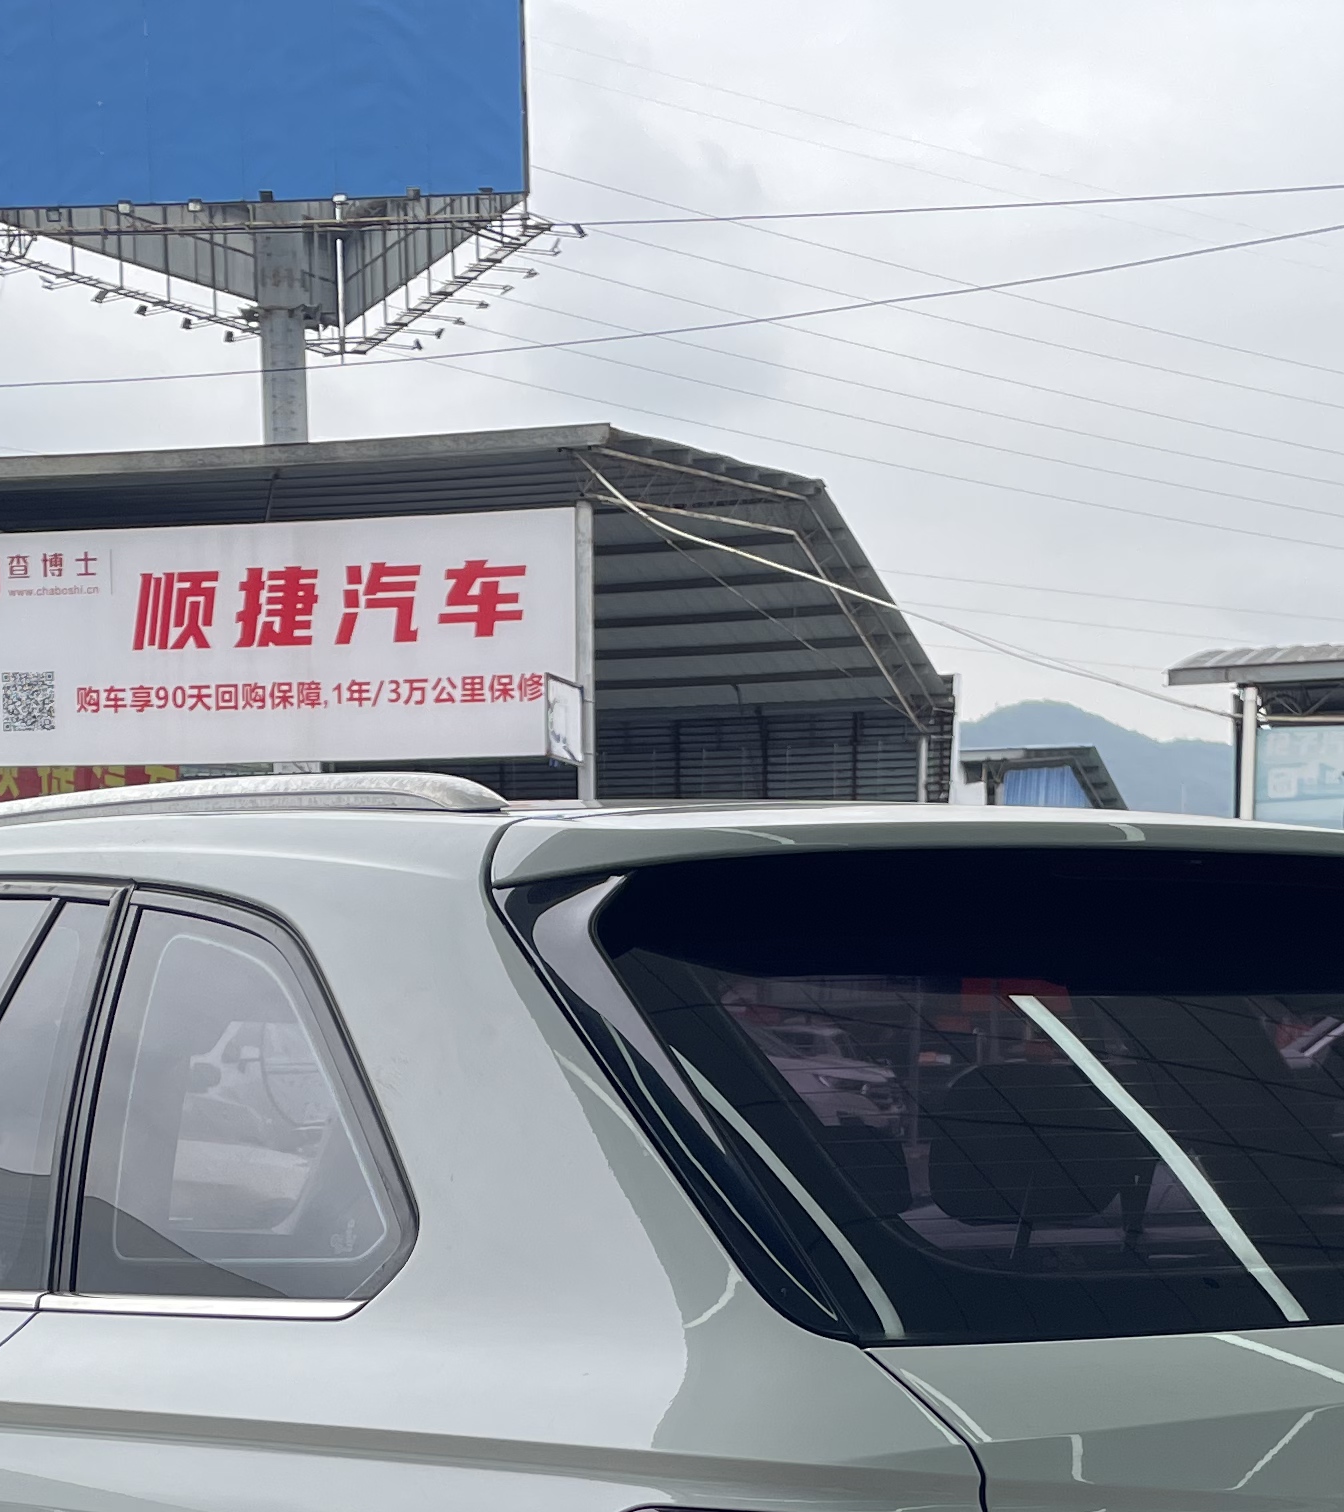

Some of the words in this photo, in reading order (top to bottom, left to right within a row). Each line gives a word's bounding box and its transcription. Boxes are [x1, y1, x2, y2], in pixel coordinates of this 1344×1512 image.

[7, 551, 97, 579] 查博士
[7, 584, 99, 597] www.chaboshi.cn
[131, 558, 528, 652] 顺捷汽车
